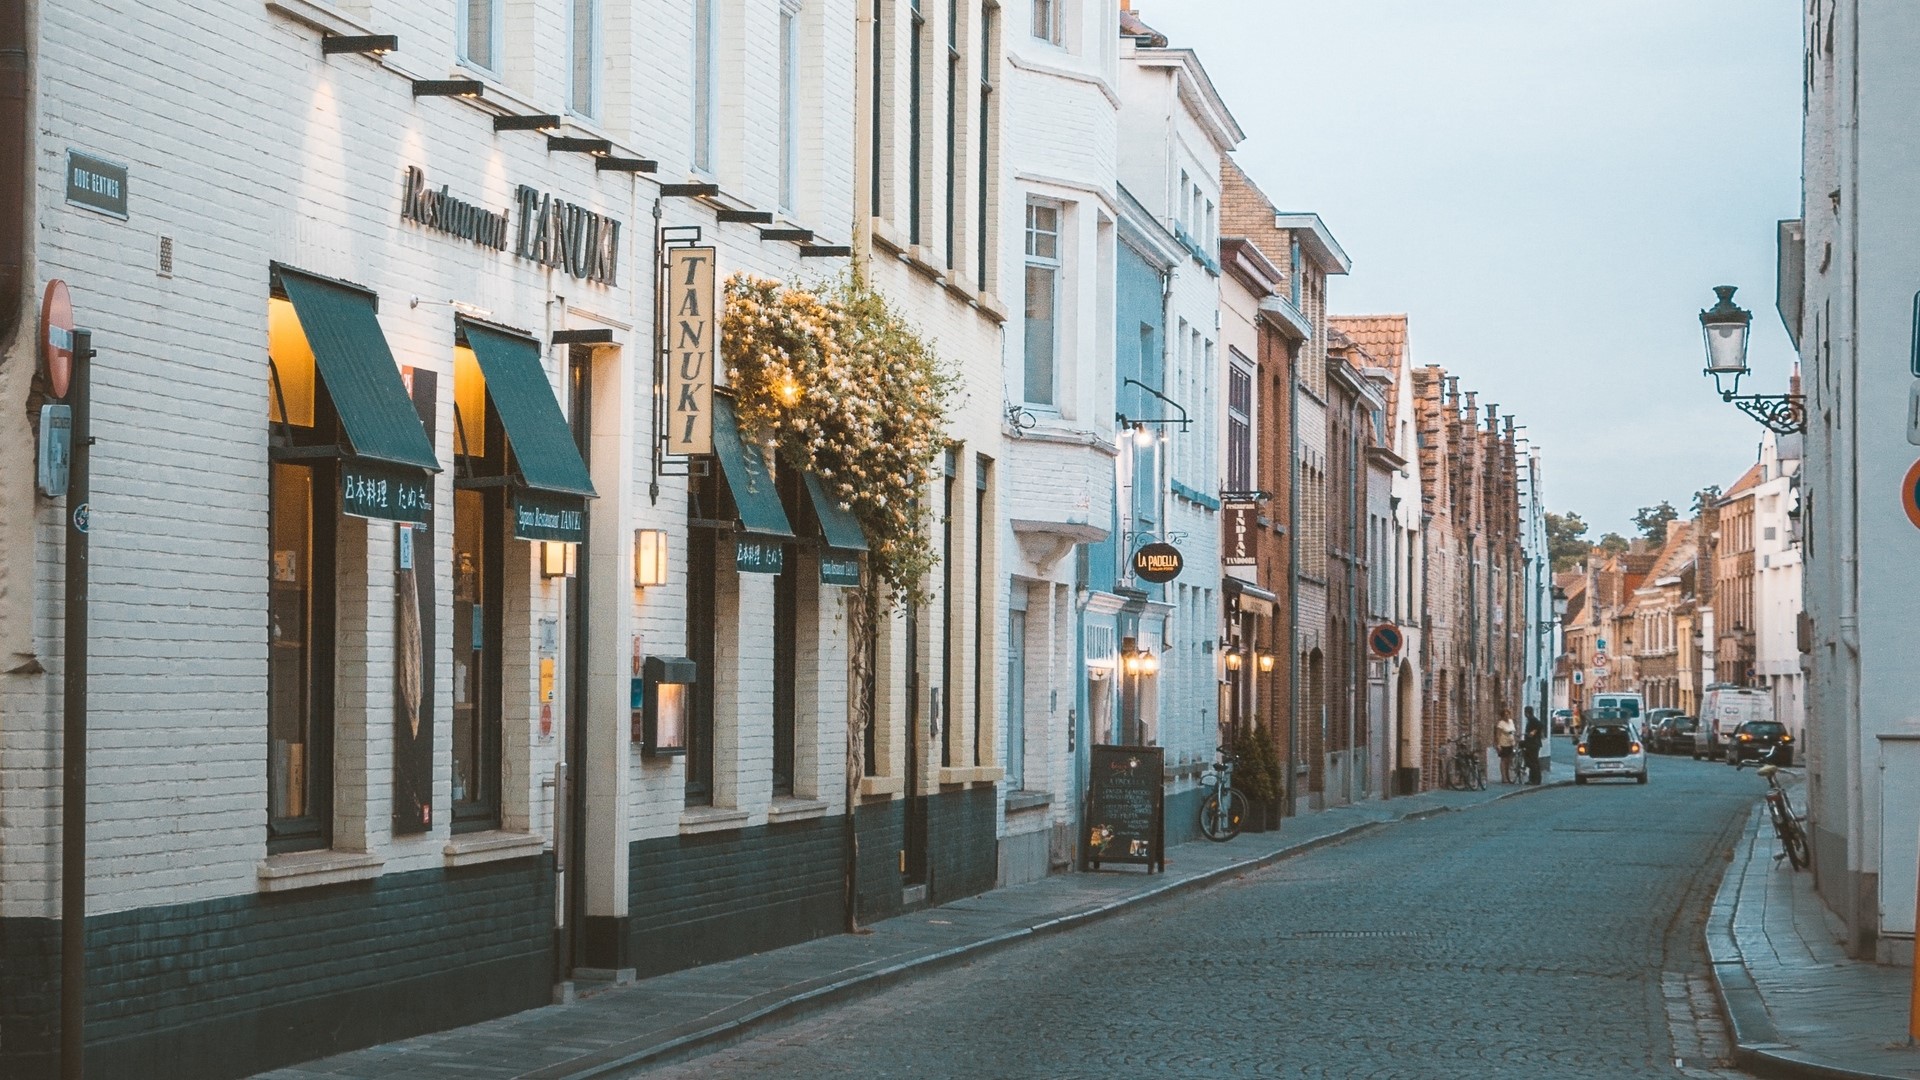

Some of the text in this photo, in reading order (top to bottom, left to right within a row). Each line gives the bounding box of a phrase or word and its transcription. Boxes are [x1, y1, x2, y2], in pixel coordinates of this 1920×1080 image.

[402, 165, 621, 287] Restaurant TANUKI
[677, 256, 706, 444] TANUKI
[345, 475, 388, 508] 日本料理
[1236, 509, 1247, 557] INDIAN
[1138, 552, 1179, 571] LA PADELLA
[1226, 557, 1256, 565] TANDOORI
